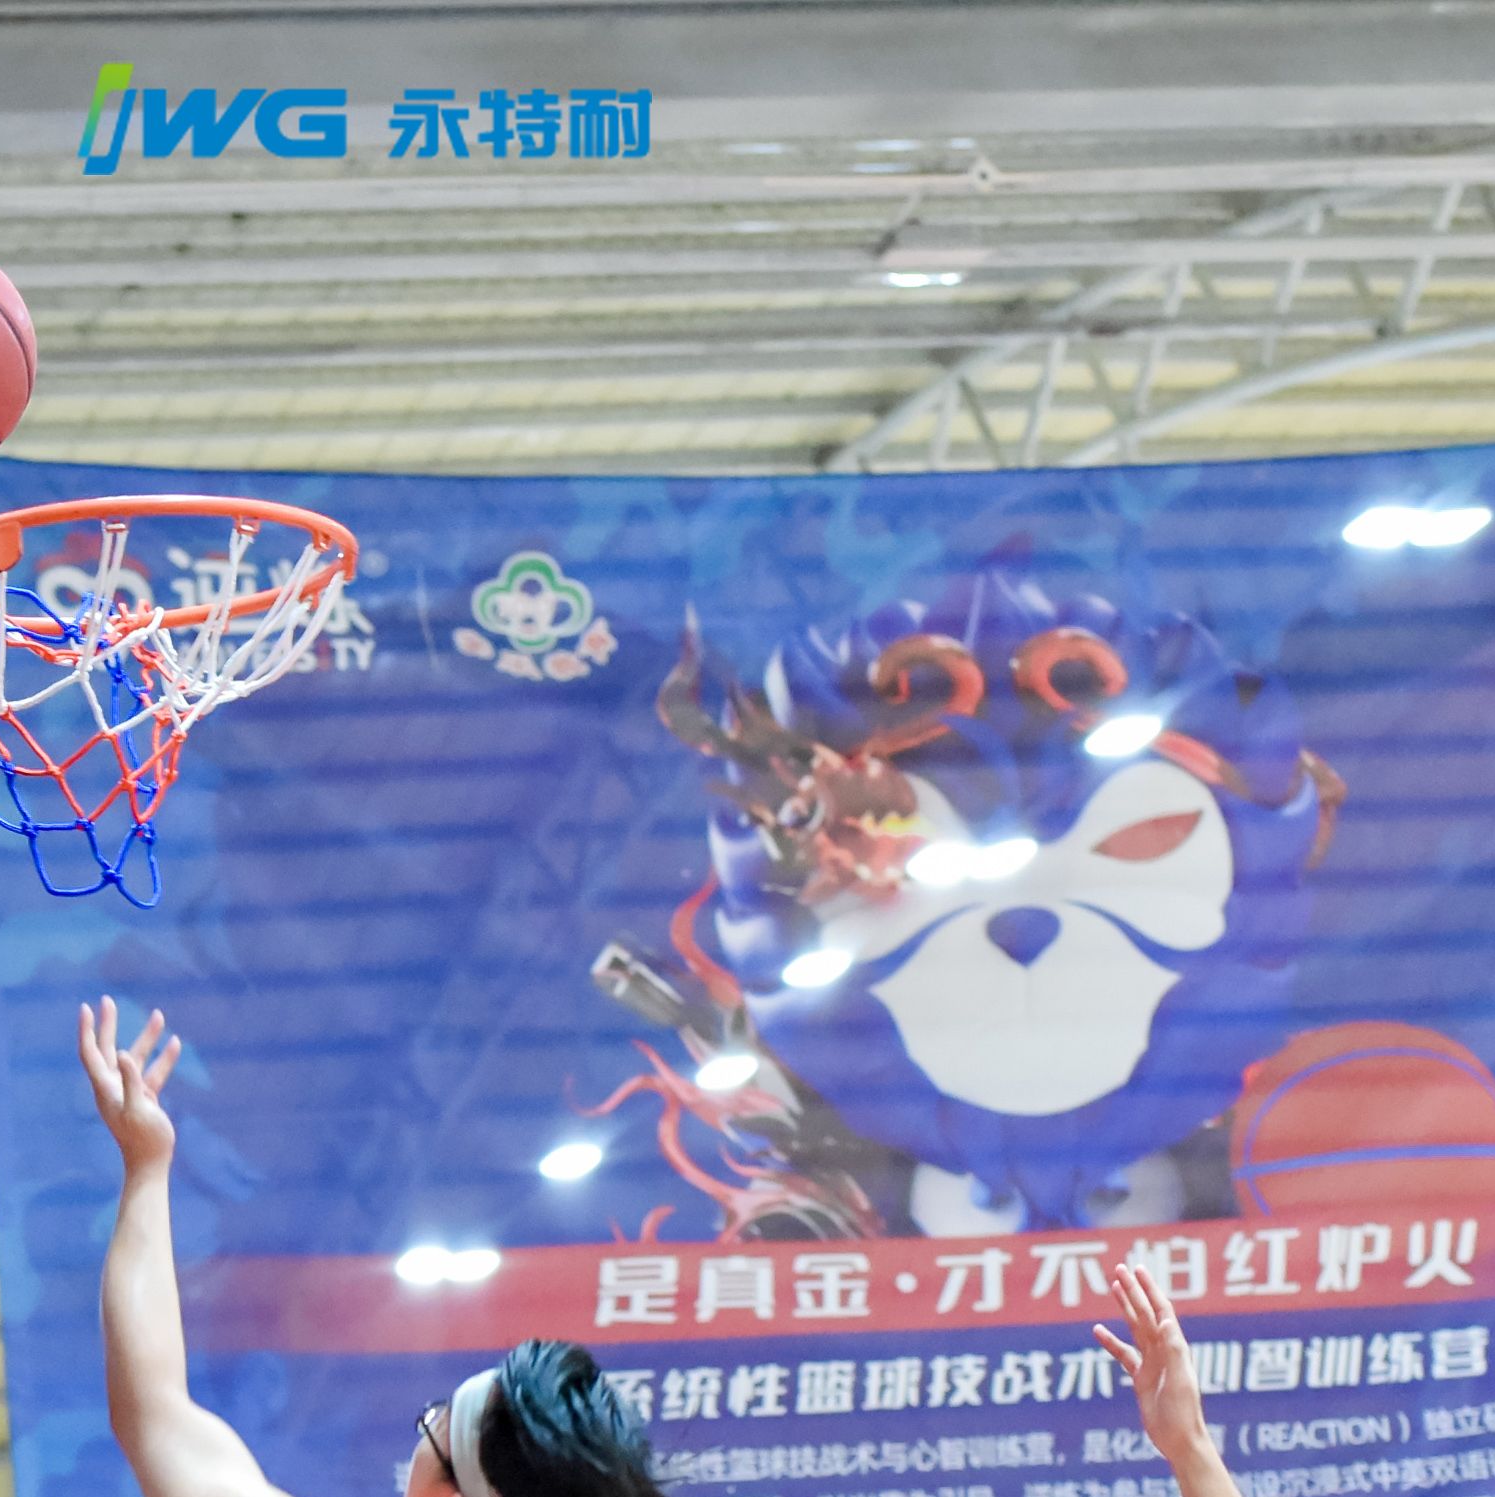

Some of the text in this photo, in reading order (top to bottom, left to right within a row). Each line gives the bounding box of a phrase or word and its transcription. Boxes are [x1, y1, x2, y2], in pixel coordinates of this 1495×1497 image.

[604, 1325, 1490, 1422] 系统性篮球技战术心智训练营
